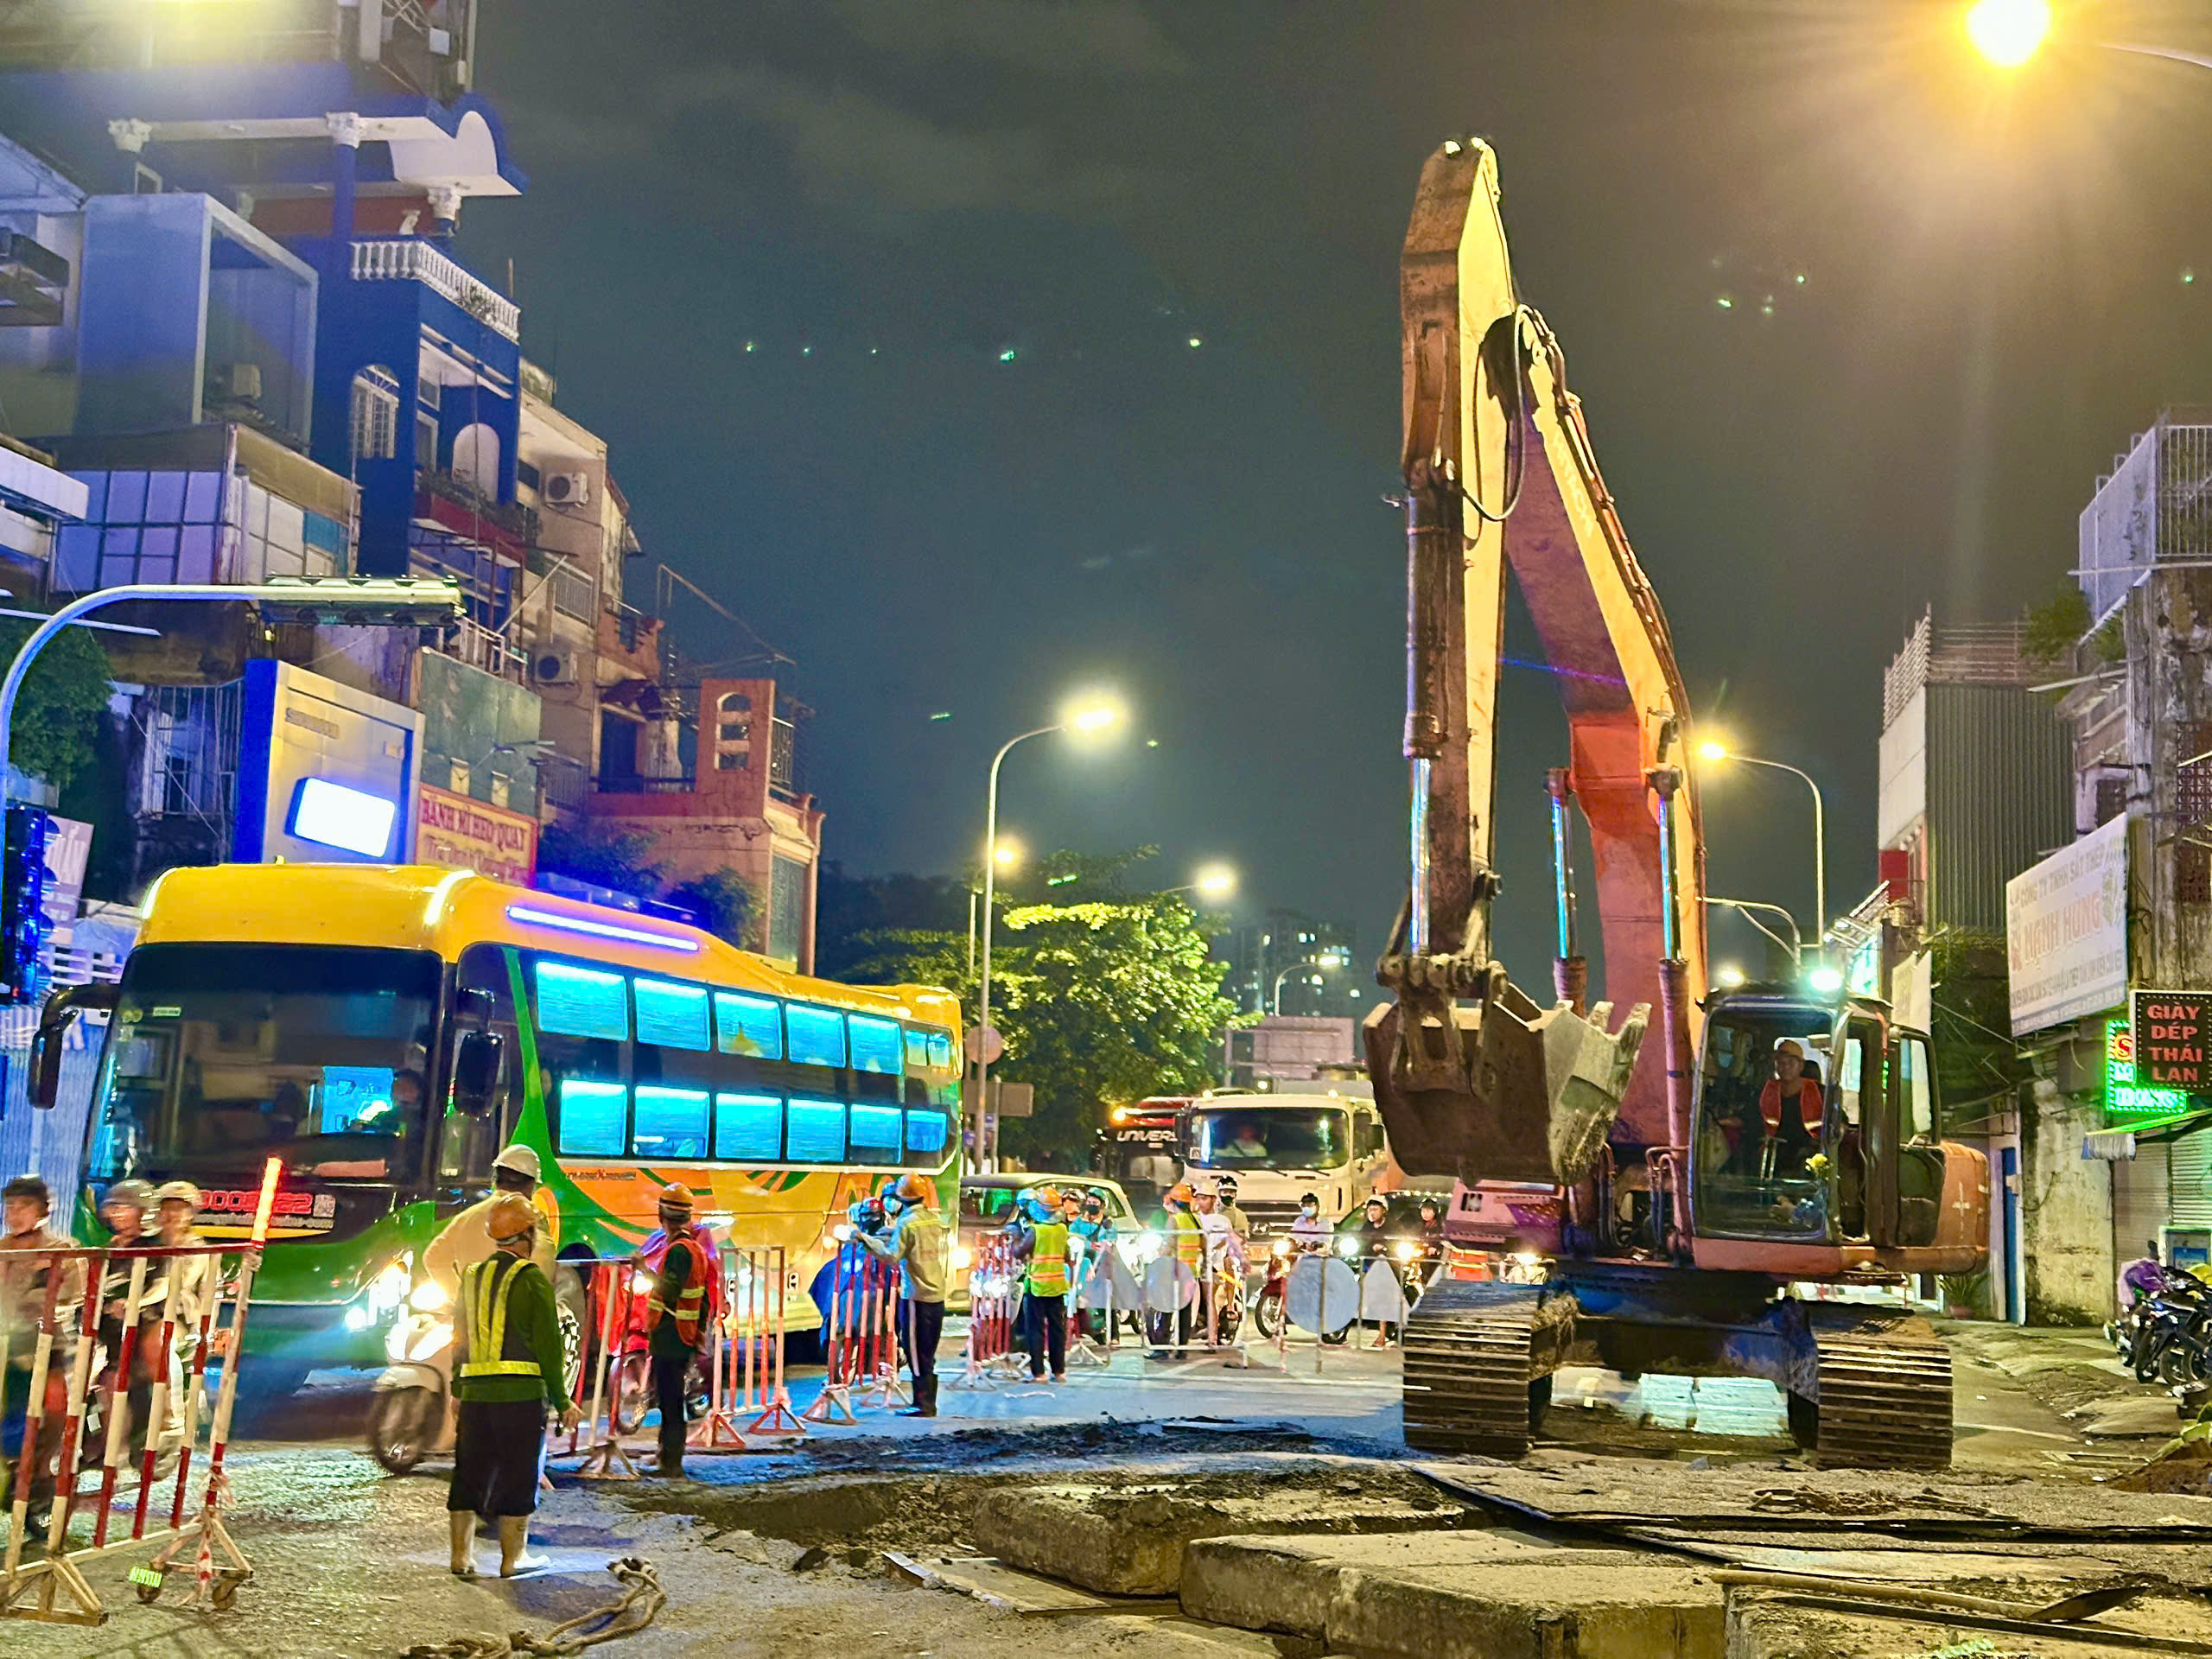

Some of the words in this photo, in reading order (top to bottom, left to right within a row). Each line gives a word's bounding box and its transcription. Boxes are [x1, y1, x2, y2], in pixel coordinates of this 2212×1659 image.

[2146, 1001, 2201, 1020] GIÀY
[2151, 1021, 2198, 1040] DÉP
[2147, 1043, 2202, 1063] THÁI
[2152, 1066, 2199, 1082] LAN
[1116, 1130, 1179, 1141] UNIVERS
